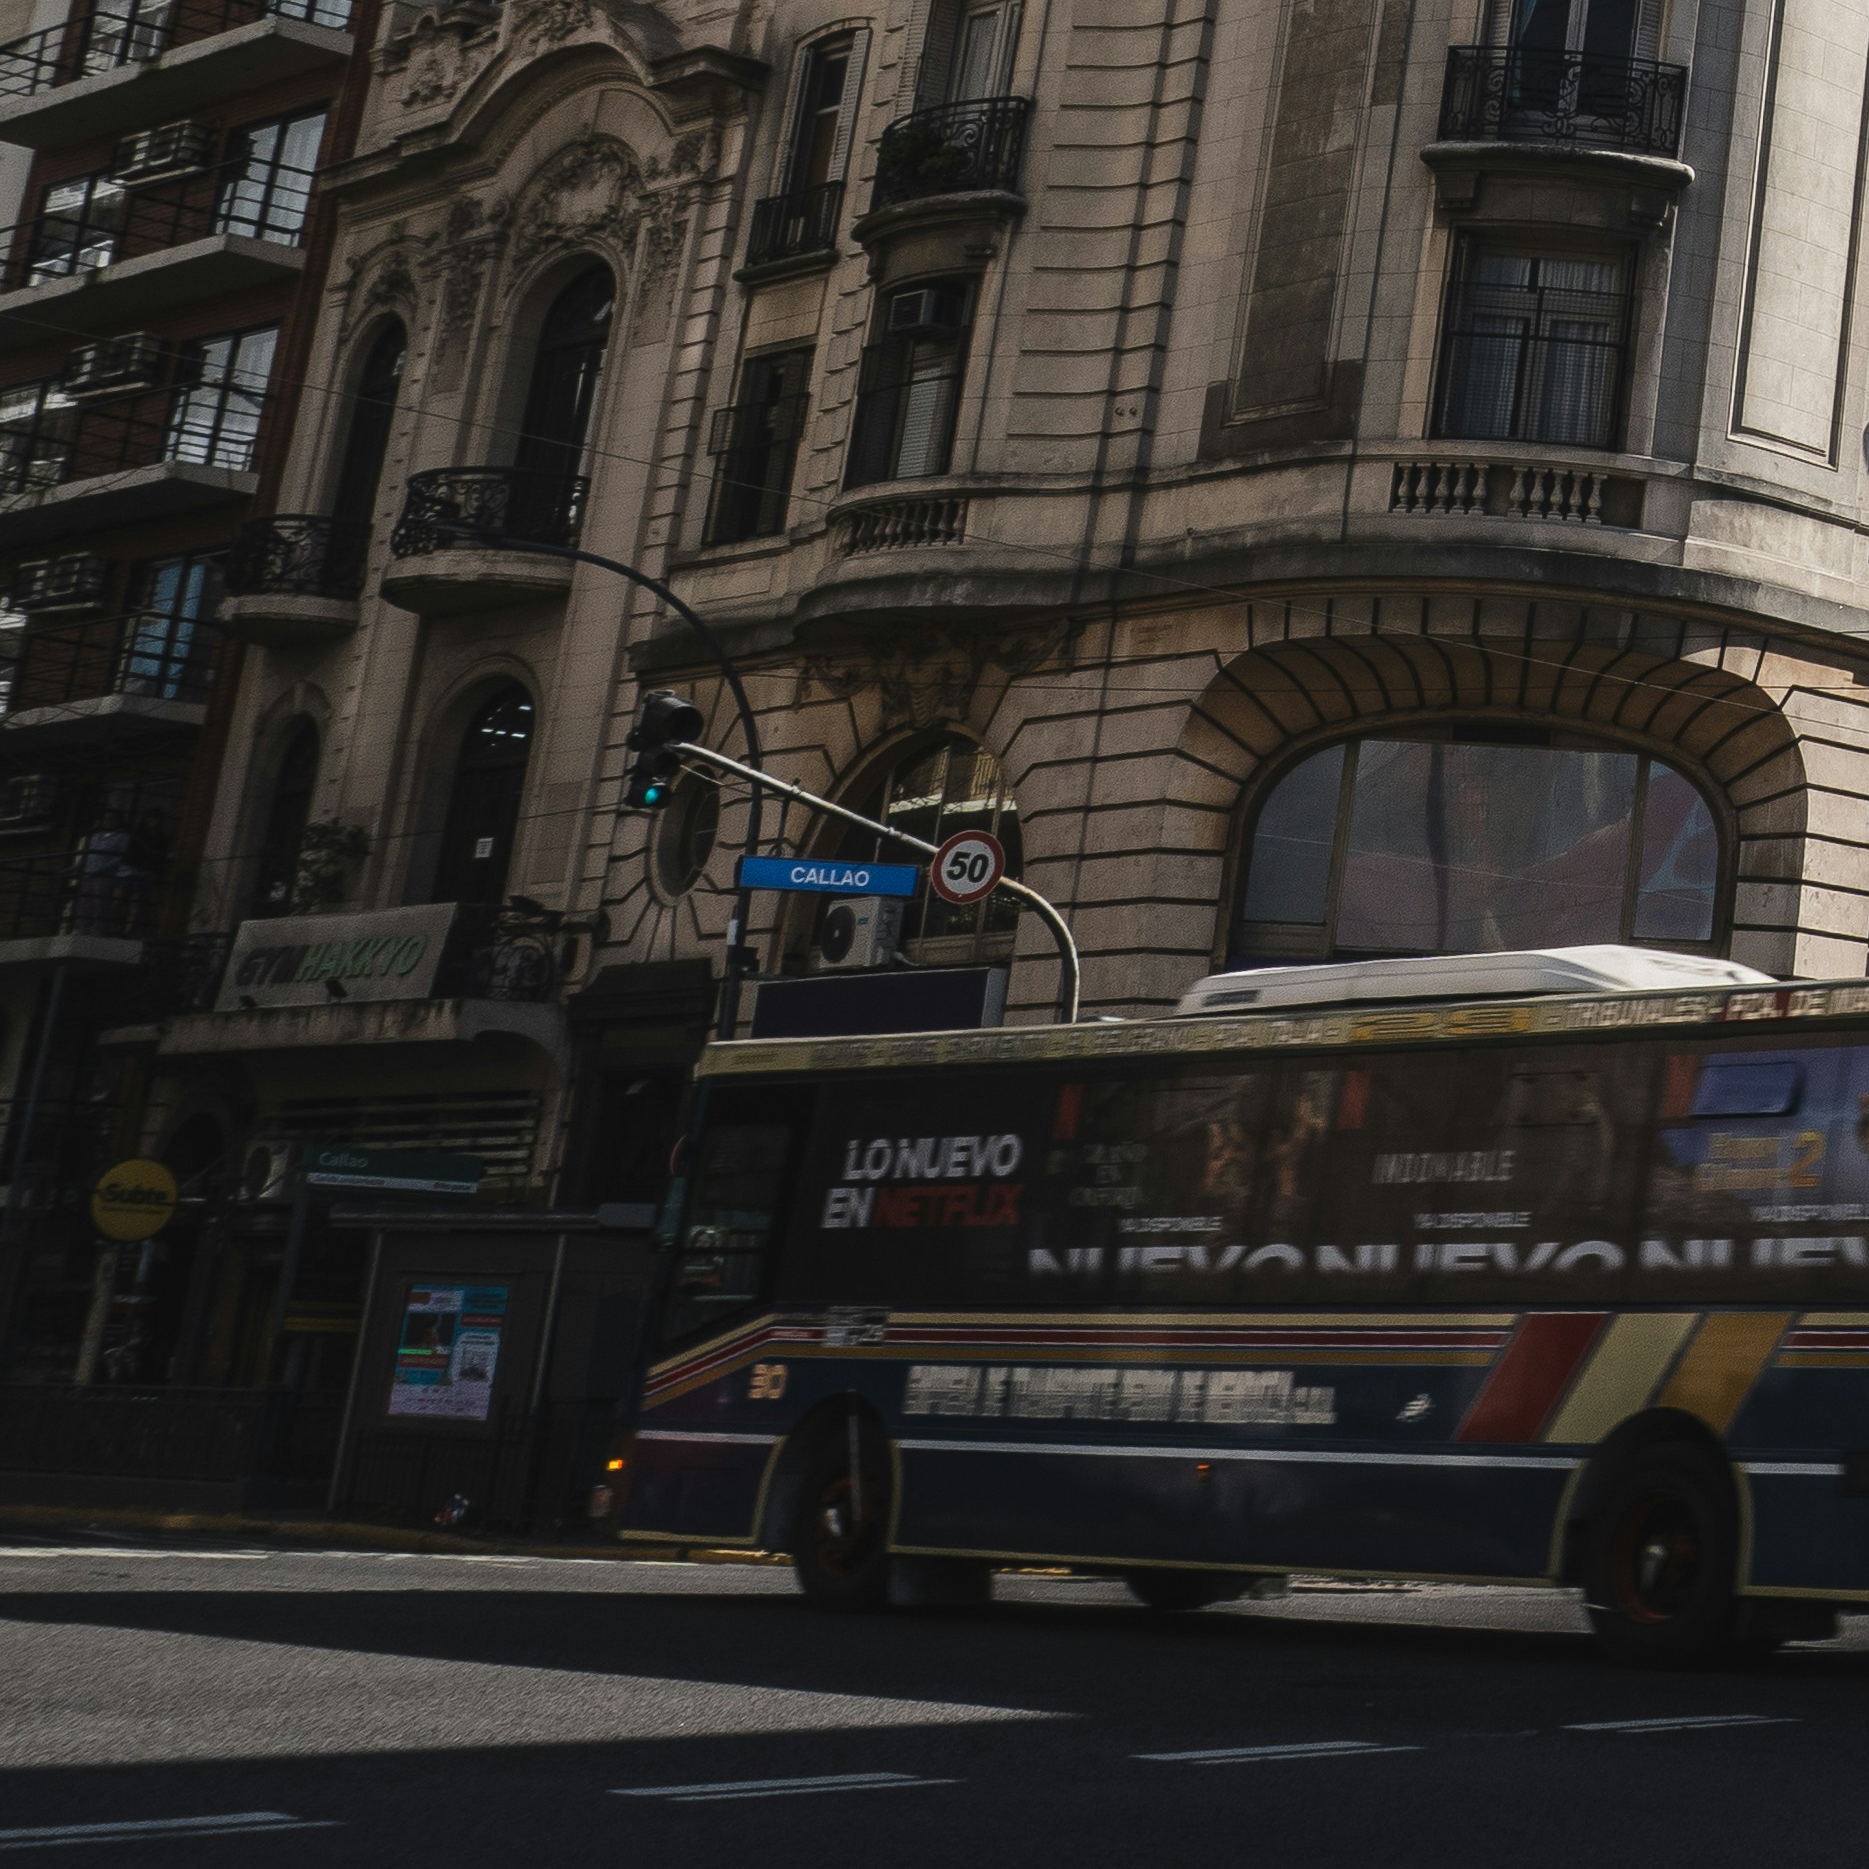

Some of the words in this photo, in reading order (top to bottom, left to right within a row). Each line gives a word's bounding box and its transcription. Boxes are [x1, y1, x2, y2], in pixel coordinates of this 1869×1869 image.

[791, 866, 870, 887] CALLAO
[946, 851, 989, 883] 50
[319, 1151, 369, 1169] Callao
[841, 1138, 893, 1181] LO
[895, 1133, 1024, 1180] NUEVO
[101, 1182, 167, 1206] Subte
[820, 1186, 876, 1229] EN
[871, 1183, 1025, 1227] NETFLIX
[1027, 1244, 1309, 1275] NUEVO
[1315, 1241, 1624, 1274] NUEVO
